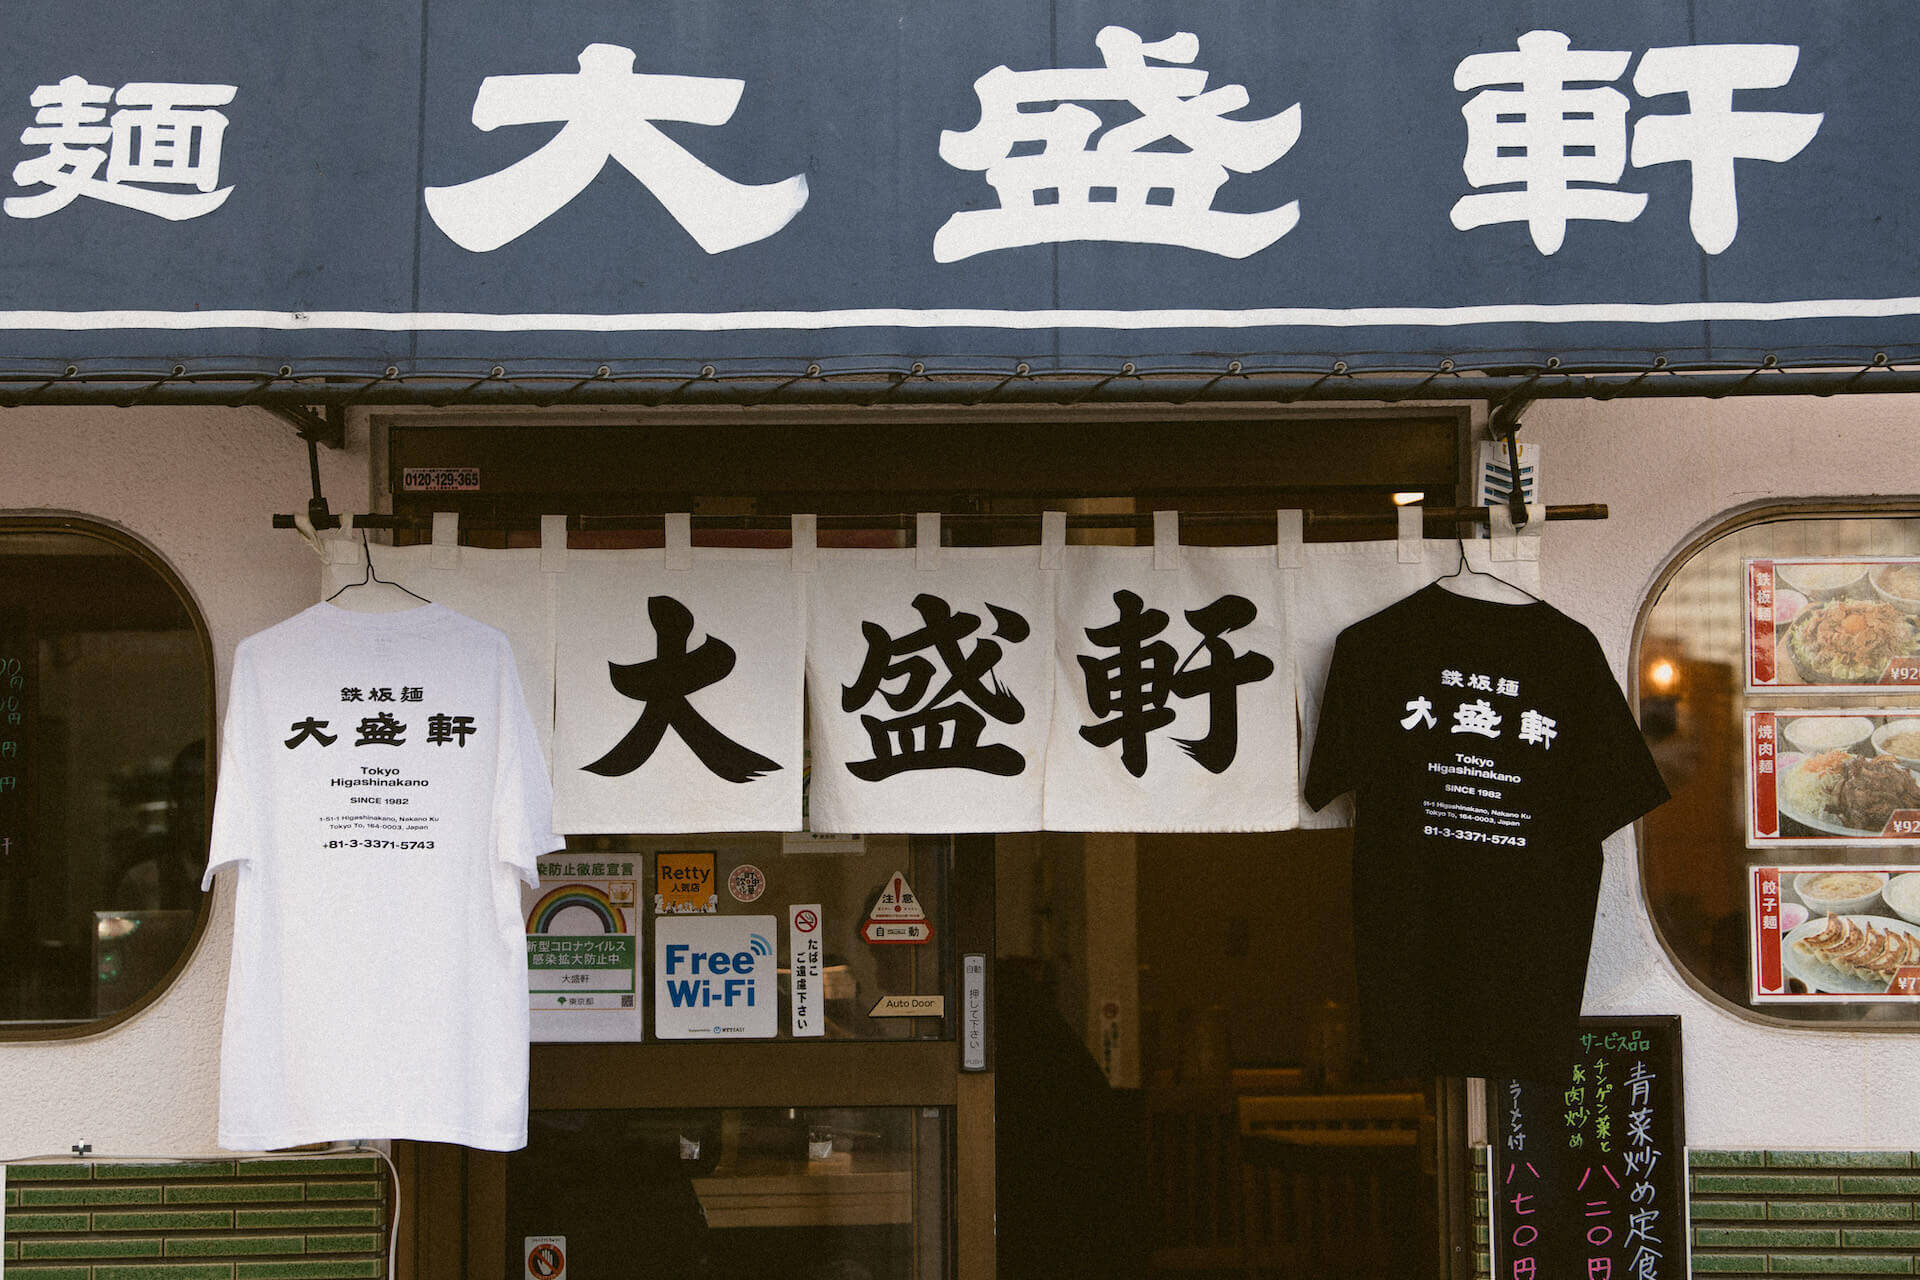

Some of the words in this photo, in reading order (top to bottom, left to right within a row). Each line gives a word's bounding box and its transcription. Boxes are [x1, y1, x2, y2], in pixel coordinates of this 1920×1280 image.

[4, 75, 238, 221] 麺
[425, 26, 1823, 262] 大盛軒
[1441, 669, 1520, 697] 鉄板麺
[1890, 667, 1920, 680] ¥92
[341, 686, 424, 702] 鉄板麺
[579, 589, 1275, 784] 大盛軒
[284, 711, 477, 749] 大盛軒
[1400, 695, 1558, 750] 大盛軒
[1455, 753, 1495, 768] Tokyo
[360, 766, 400, 777] Tokyo
[1428, 762, 1522, 784] Higashinakano
[330, 777, 429, 788] Higashinakano
[1444, 783, 1476, 796] SINCE
[1477, 788, 1502, 800] 1982
[350, 796, 382, 804] SINCE
[385, 797, 409, 805] 1982
[341, 814, 398, 823] Higashinakano,
[1425, 808, 1447, 818] Tokyo
[1497, 819, 1521, 828] Japan
[1491, 809, 1520, 819] Nakano
[322, 839, 435, 850] +81-3-3371-5743
[661, 866, 711, 884] Retty
[671, 883, 700, 893] 人気店
[1762, 880, 1777, 930] 餃子麺
[527, 940, 626, 952] 新型コロナウイルス
[532, 953, 620, 966] 感染拡大防止中
[665, 944, 755, 975] Free
[808, 939, 818, 976] たばこ
[796, 952, 808, 1030] ご遠慮下さい
[1898, 976, 1920, 990] ¥7
[666, 979, 755, 1008] Wi-Fi
[886, 999, 910, 1009] Auto
[912, 999, 936, 1009] Door
[969, 988, 980, 1050] 押して下さい
[1579, 1029, 1651, 1054] サービス品
[1507, 1079, 1526, 1151] ラーメン付
[1623, 1060, 1664, 1280] 青菜炒め定食
